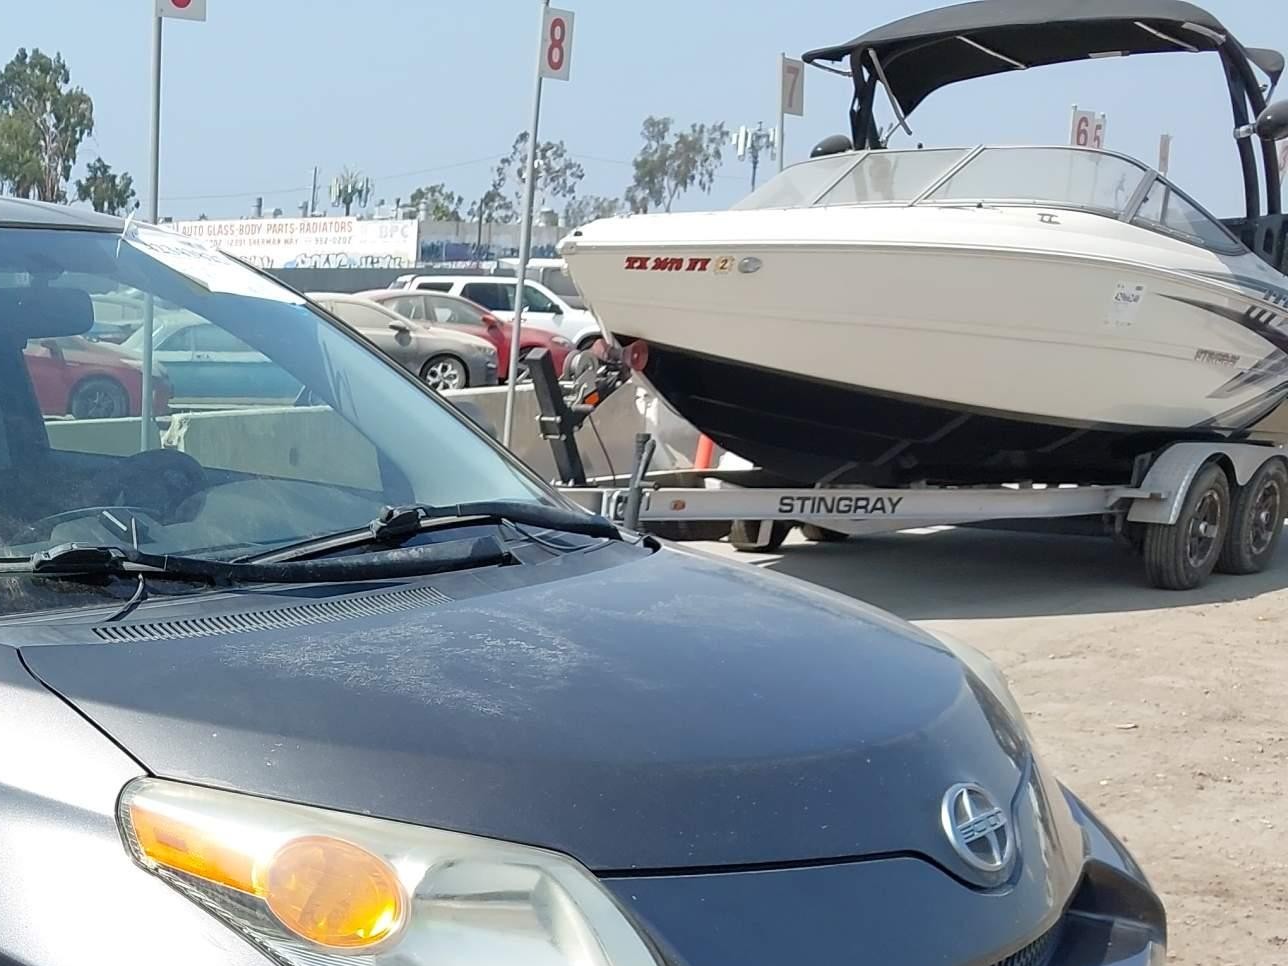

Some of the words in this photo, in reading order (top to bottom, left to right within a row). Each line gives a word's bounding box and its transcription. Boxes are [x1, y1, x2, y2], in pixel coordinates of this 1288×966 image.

[547, 17, 566, 71] 8
[786, 66, 800, 108] 7
[1076, 116, 1089, 147] 6
[182, 225, 204, 237] AUTO
[778, 496, 904, 514] STINGRAY
